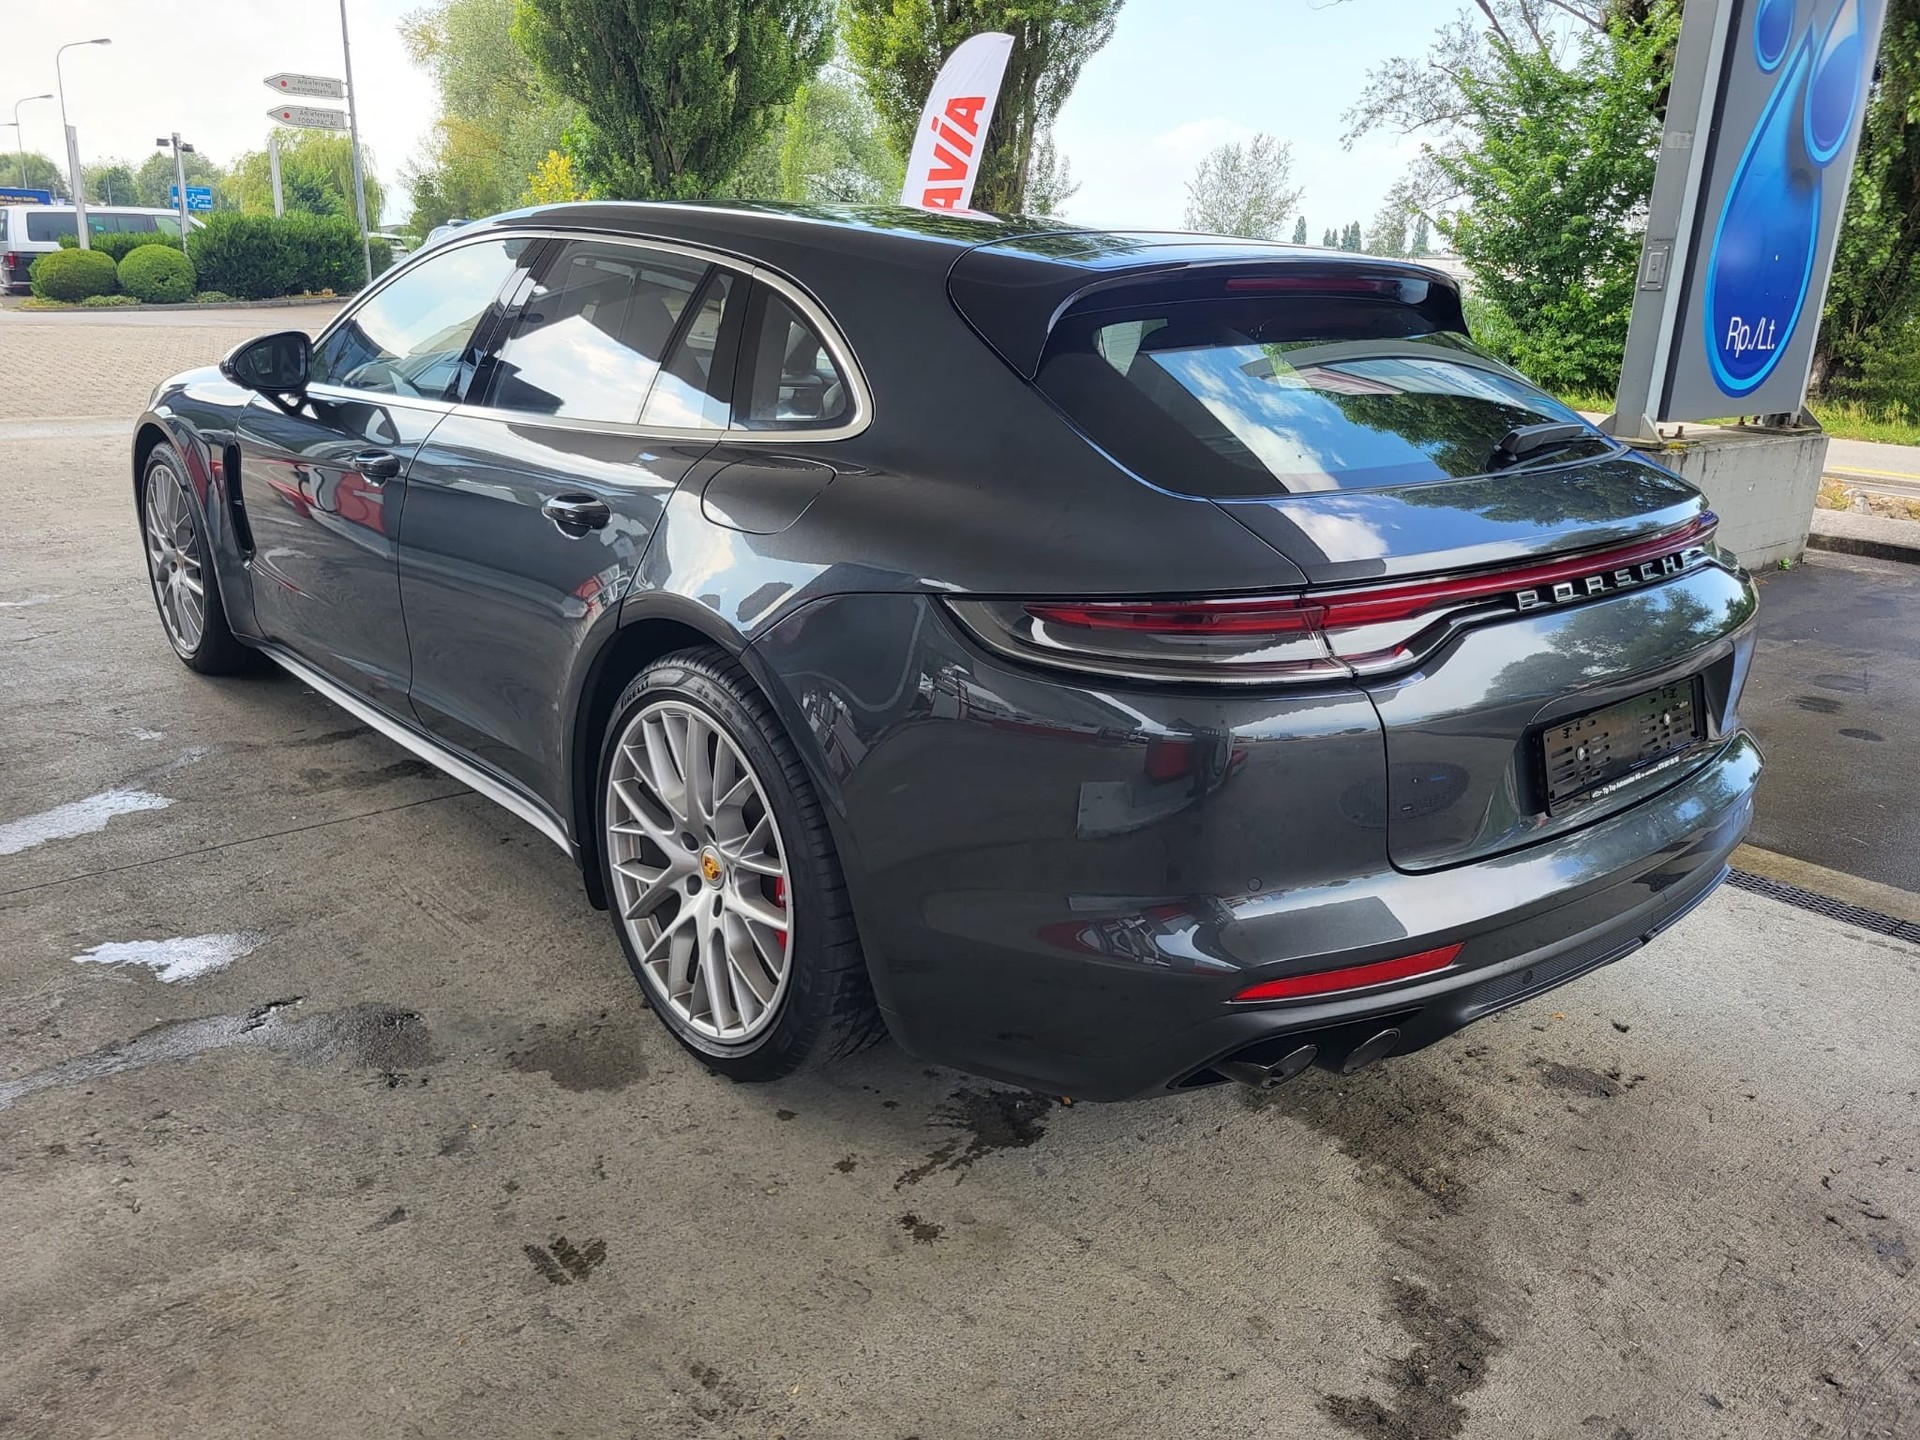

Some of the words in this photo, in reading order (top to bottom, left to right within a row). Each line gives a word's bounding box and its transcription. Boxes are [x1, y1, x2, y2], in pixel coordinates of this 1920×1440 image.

[922, 97, 986, 209] AVIA
[1726, 316, 1775, 358] Rp./Lt.
[1516, 550, 1697, 612] PORSCHE
